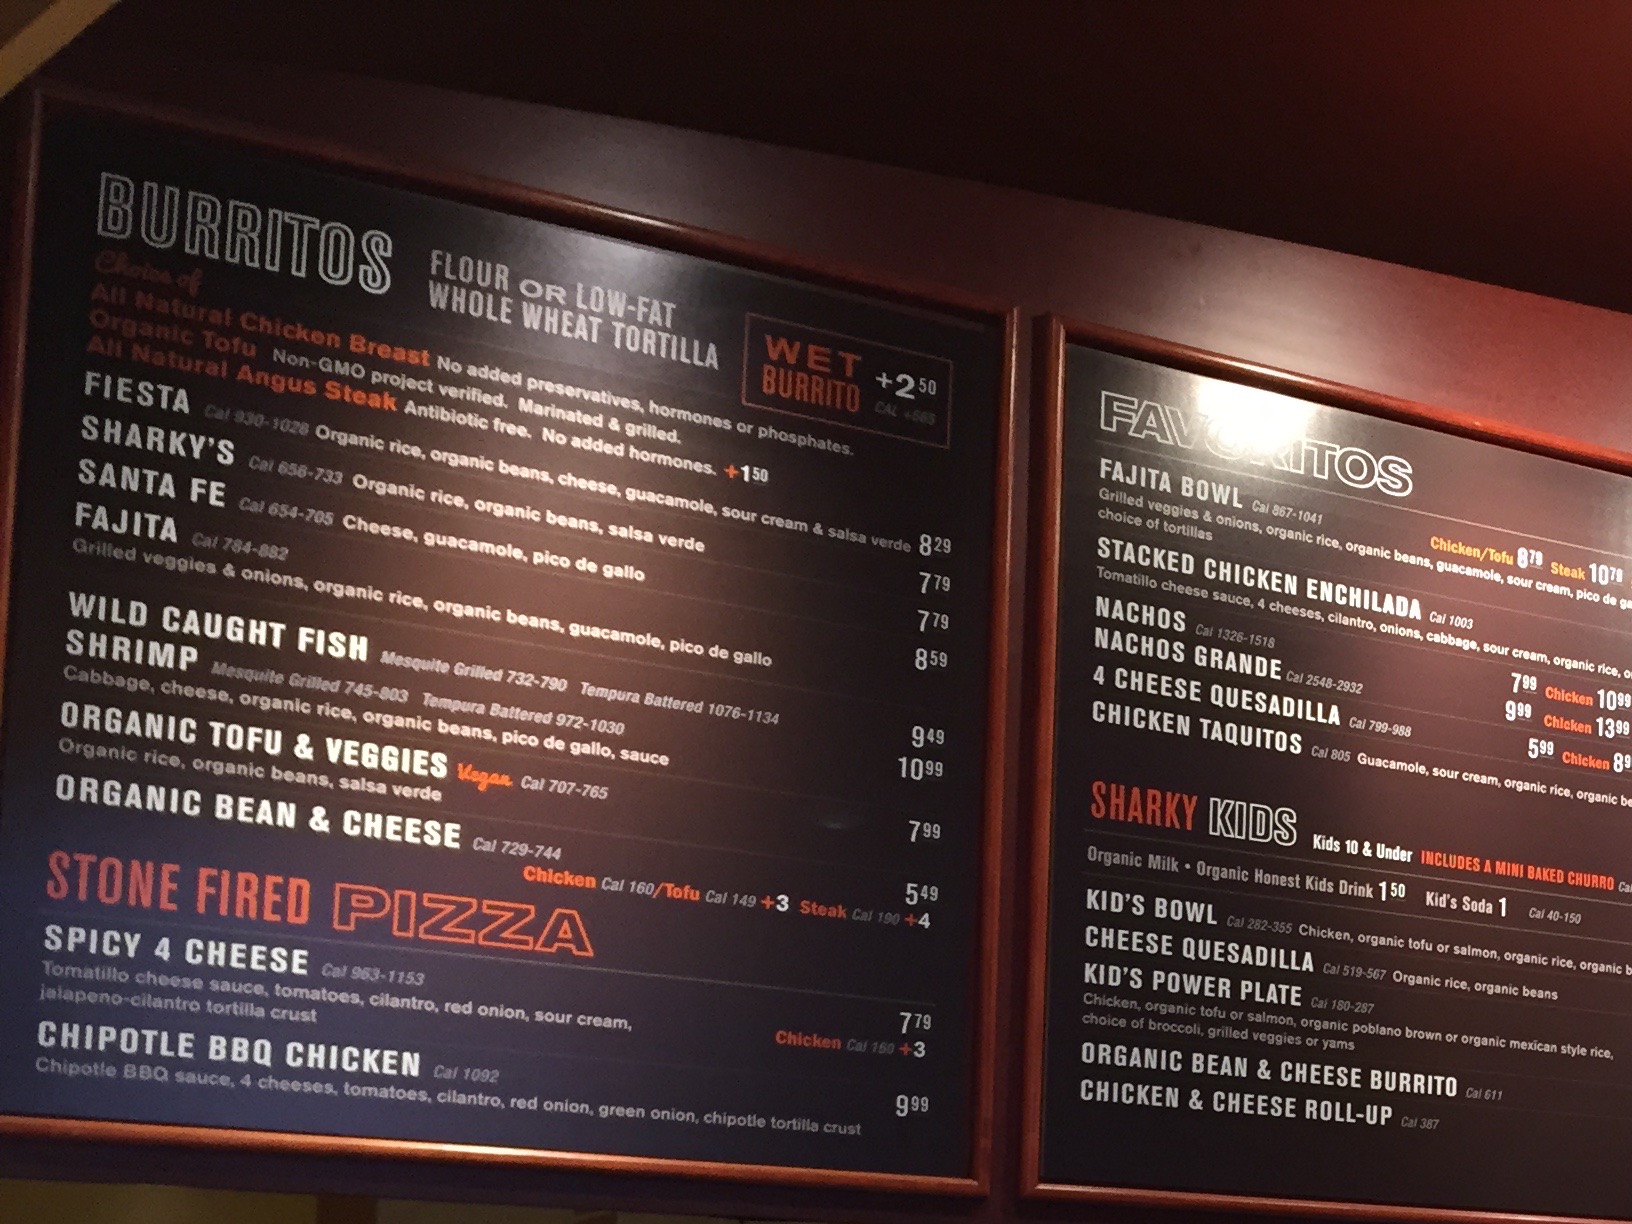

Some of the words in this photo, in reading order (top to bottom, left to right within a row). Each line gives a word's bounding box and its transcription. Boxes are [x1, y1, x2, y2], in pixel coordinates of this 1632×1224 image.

[97, 172, 392, 295] BURRITOS
[430, 250, 509, 291] FLOUR
[519, 279, 567, 304] OR
[576, 284, 676, 328] LOW-FAT
[429, 280, 512, 325] WHOLE
[523, 303, 601, 344] WHEAT
[613, 322, 719, 370] TORTILLA
[765, 334, 862, 376] WET
[84, 370, 191, 414] FIESTA
[437, 356, 462, 375] No
[466, 362, 521, 388] added
[527, 374, 645, 414] preservatives,
[648, 400, 732, 430] hormones
[737, 420, 753, 435] or
[758, 424, 854, 456] phosphates.
[762, 364, 861, 412] BURRITO
[81, 415, 235, 467] SHARKY'S
[78, 459, 176, 500] SANTA
[191, 476, 227, 507] FE
[1100, 457, 1171, 494] FAJITA
[1181, 476, 1243, 509] BOWL
[75, 502, 178, 544] FAJITA
[1097, 536, 1195, 575] STACKED
[1204, 557, 1297, 596] CHICKEN
[1306, 578, 1422, 621] ENCHILADA
[68, 591, 149, 627] WILD
[162, 606, 286, 650] CAUGHT
[299, 626, 369, 662] FISH
[1095, 596, 1187, 632] NACHOS
[66, 629, 199, 672] SHRIMP
[1094, 628, 1185, 663] NACHOS
[1194, 646, 1282, 680] GRANDE
[1093, 666, 1105, 685] 4
[1115, 668, 1202, 702] CHEESE
[1211, 685, 1340, 726] QUESADILLA
[61, 701, 197, 744] ORGANIC
[210, 720, 282, 756] TOFU
[326, 738, 449, 779] VEGGIES
[457, 763, 513, 791] Vegan
[1092, 701, 1190, 736] CHICKEN
[1200, 718, 1302, 754] TAQUITOS
[56, 774, 201, 817] ORGANIC
[214, 793, 296, 829] BEAN
[343, 810, 462, 849] CHEESE
[1091, 781, 1198, 830] SHARKY
[1208, 797, 1297, 846] KIDS
[1313, 834, 1341, 852] Kids
[1345, 839, 1358, 854] 10
[1377, 843, 1413, 862] Under
[1421, 850, 1480, 872] INCLUDES
[1495, 862, 1524, 878] MINI
[1528, 866, 1564, 884] BAKED
[1567, 872, 1614, 891] CHURRO
[1087, 846, 1142, 867] Organic
[1148, 854, 1179, 873] Milk
[1197, 861, 1249, 883] Organic
[1254, 869, 1301, 889] Honest
[1305, 875, 1334, 893] Kids
[1339, 881, 1373, 899] Drink
[47, 850, 180, 911] STONE
[197, 867, 311, 924] FIRED
[333, 882, 594, 957] PIZZA
[1086, 888, 1145, 914] KID'S
[1155, 897, 1217, 925] BOWL
[44, 924, 142, 961] SPICY
[155, 937, 171, 963] 4
[185, 938, 309, 976] CHEESE
[37, 1020, 195, 1058] CHIPOTLE
[208, 1036, 273, 1067] BBQ
[285, 1042, 421, 1078] CHICKEN
[1080, 1079, 1179, 1108] CHICKEN
[1212, 1090, 1297, 1118] CHEESE
[1305, 1100, 1393, 1126] ROLL-UP
